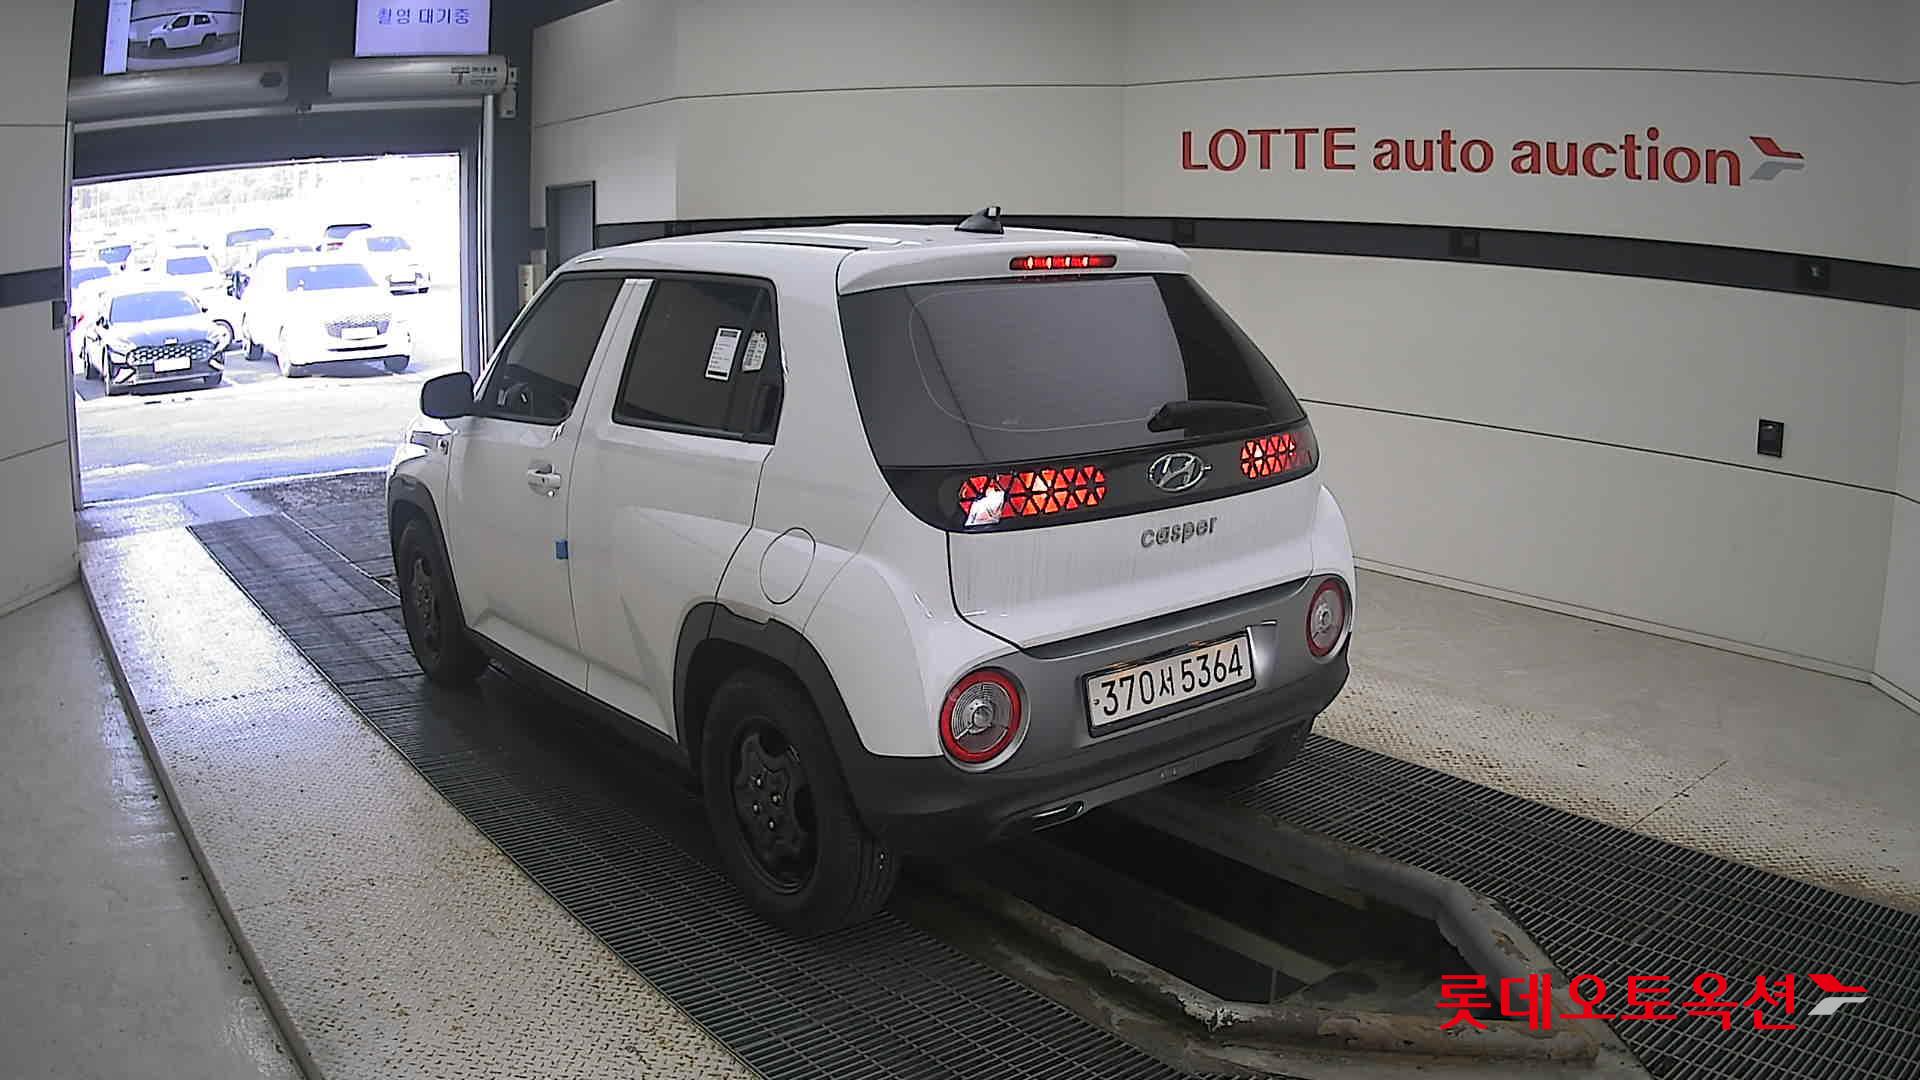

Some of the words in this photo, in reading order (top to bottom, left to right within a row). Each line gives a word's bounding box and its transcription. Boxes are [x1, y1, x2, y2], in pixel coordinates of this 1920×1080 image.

[418, 7, 470, 25] 대기중
[1181, 127, 1356, 172] LOTTE
[1373, 129, 1495, 173] auto
[1511, 126, 1742, 187] auction
[1140, 516, 1217, 548] casper
